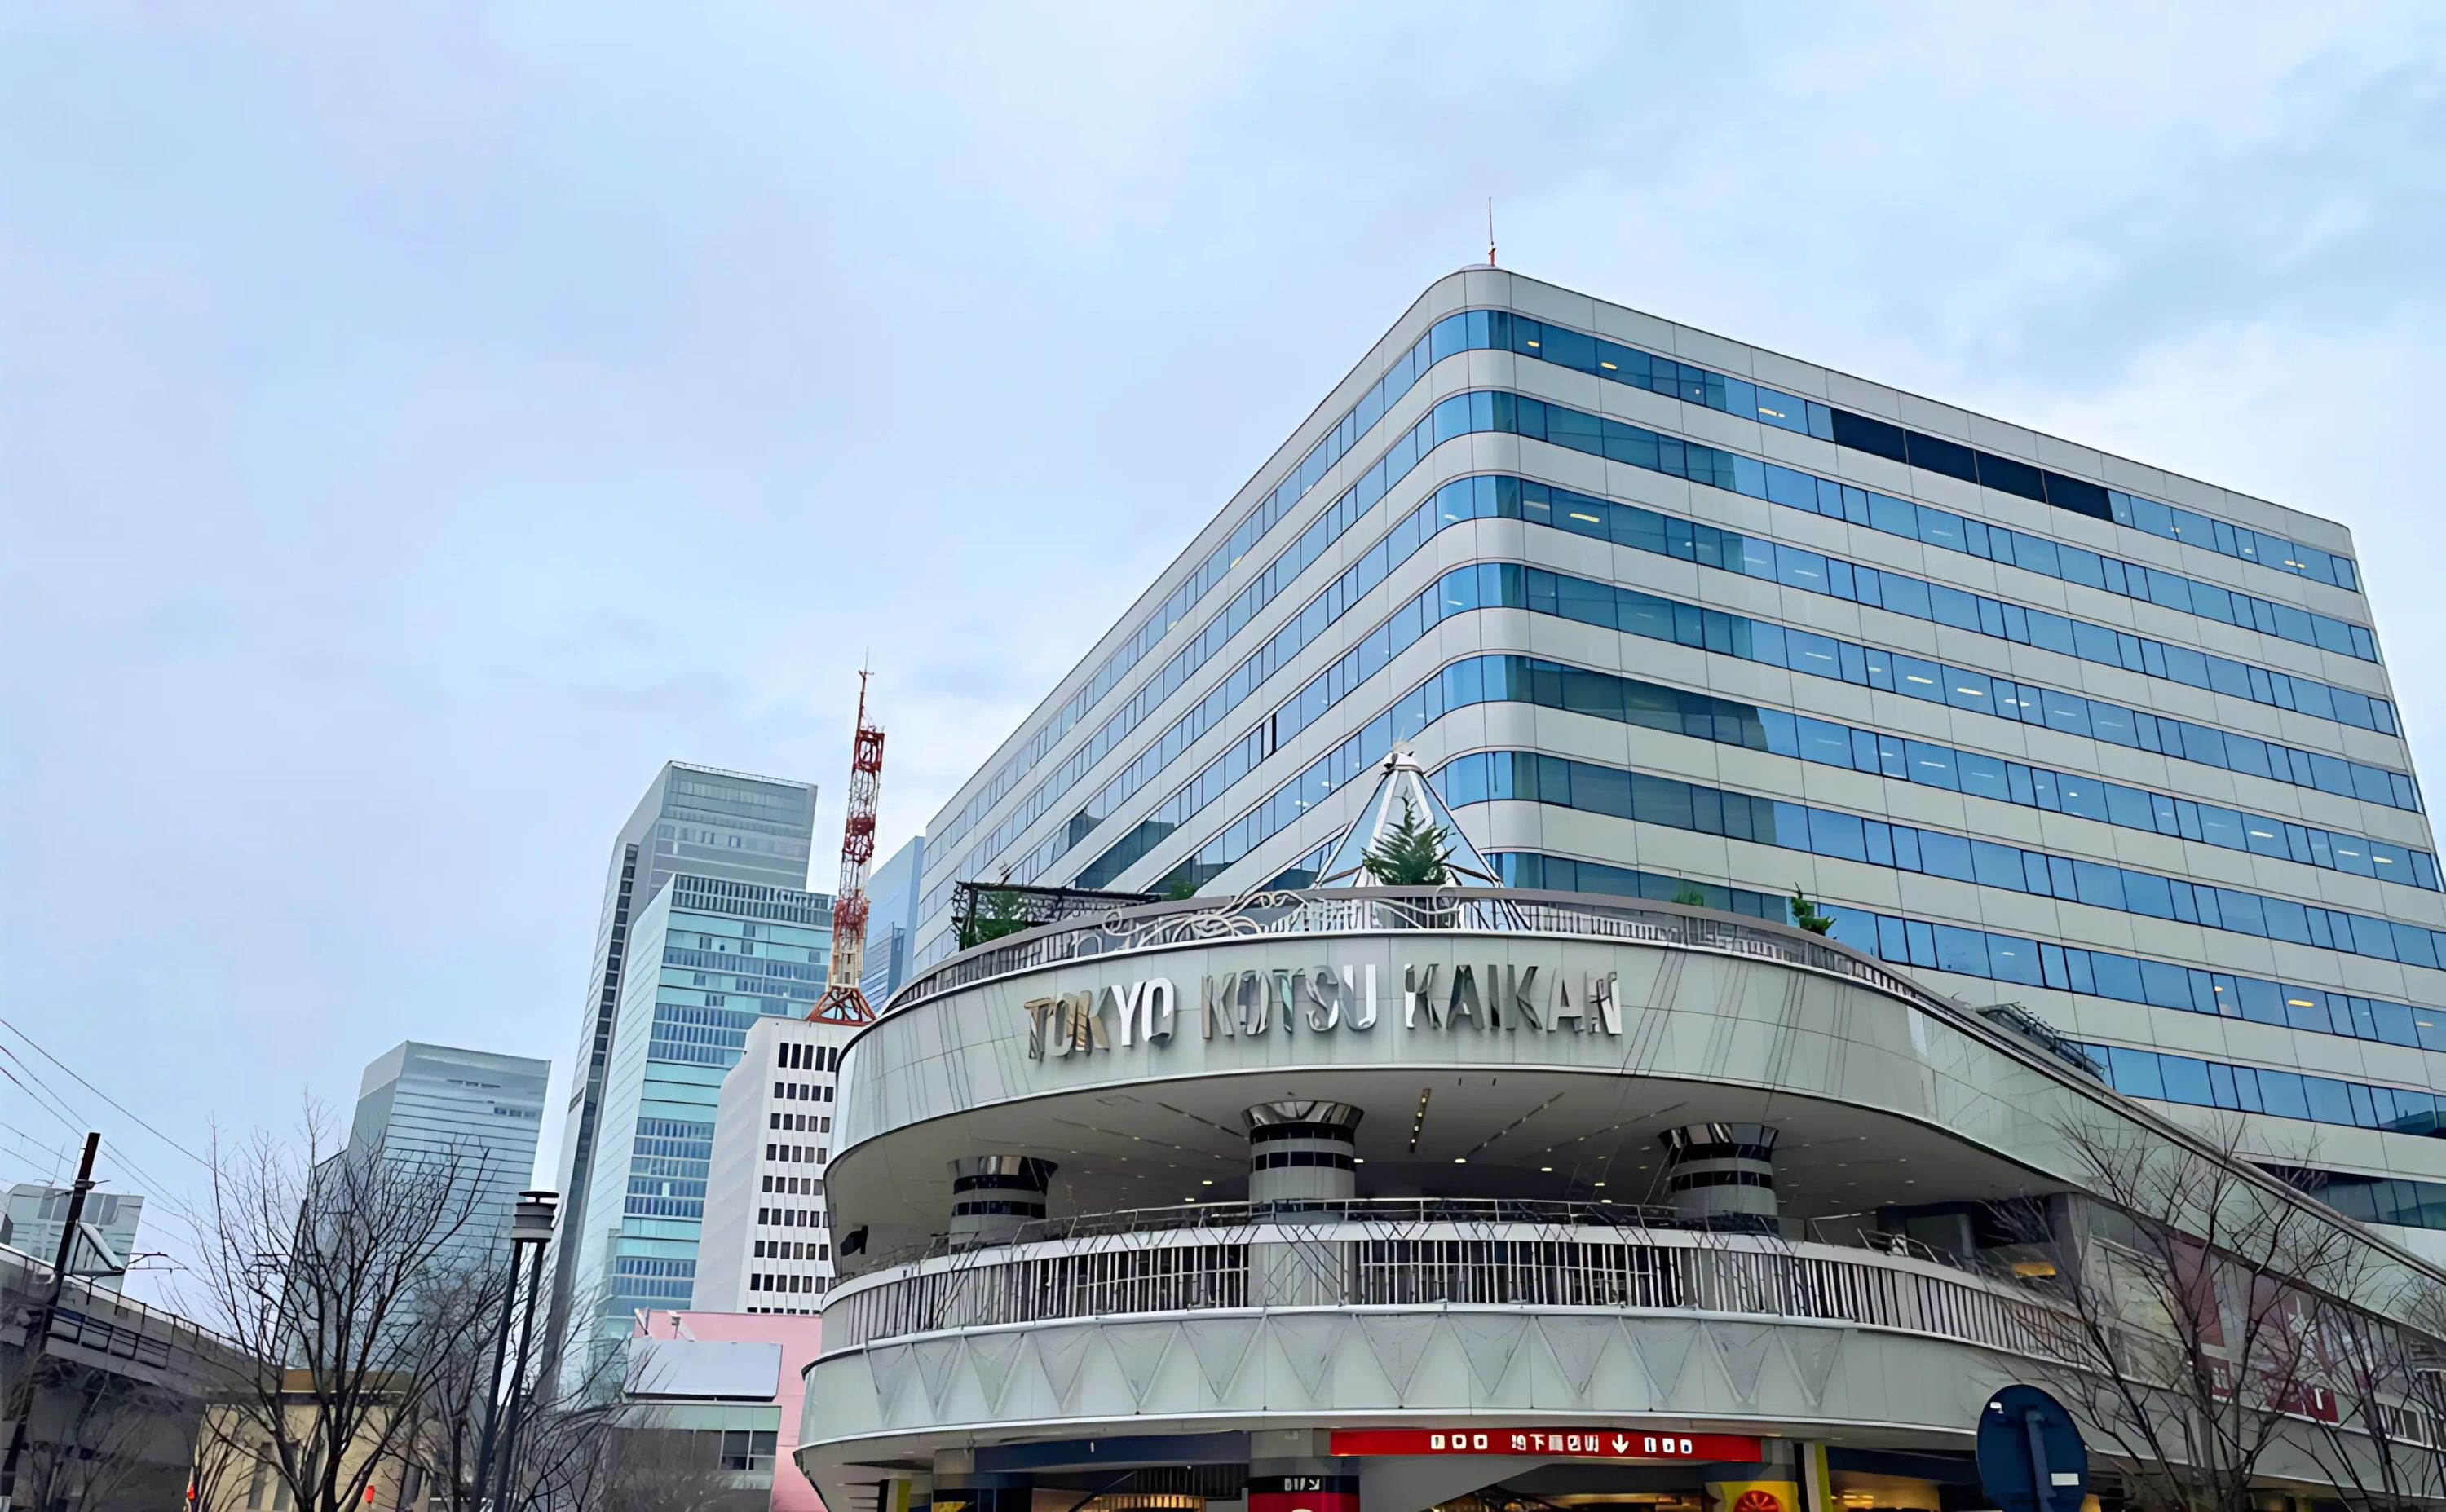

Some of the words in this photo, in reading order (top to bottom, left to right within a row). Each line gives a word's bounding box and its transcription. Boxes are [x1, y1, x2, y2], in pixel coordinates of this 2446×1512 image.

[1024, 977, 1175, 1060] TOKYO
[1201, 963, 1378, 1038] KOTSU
[1404, 963, 1623, 1035] KAIKAN
